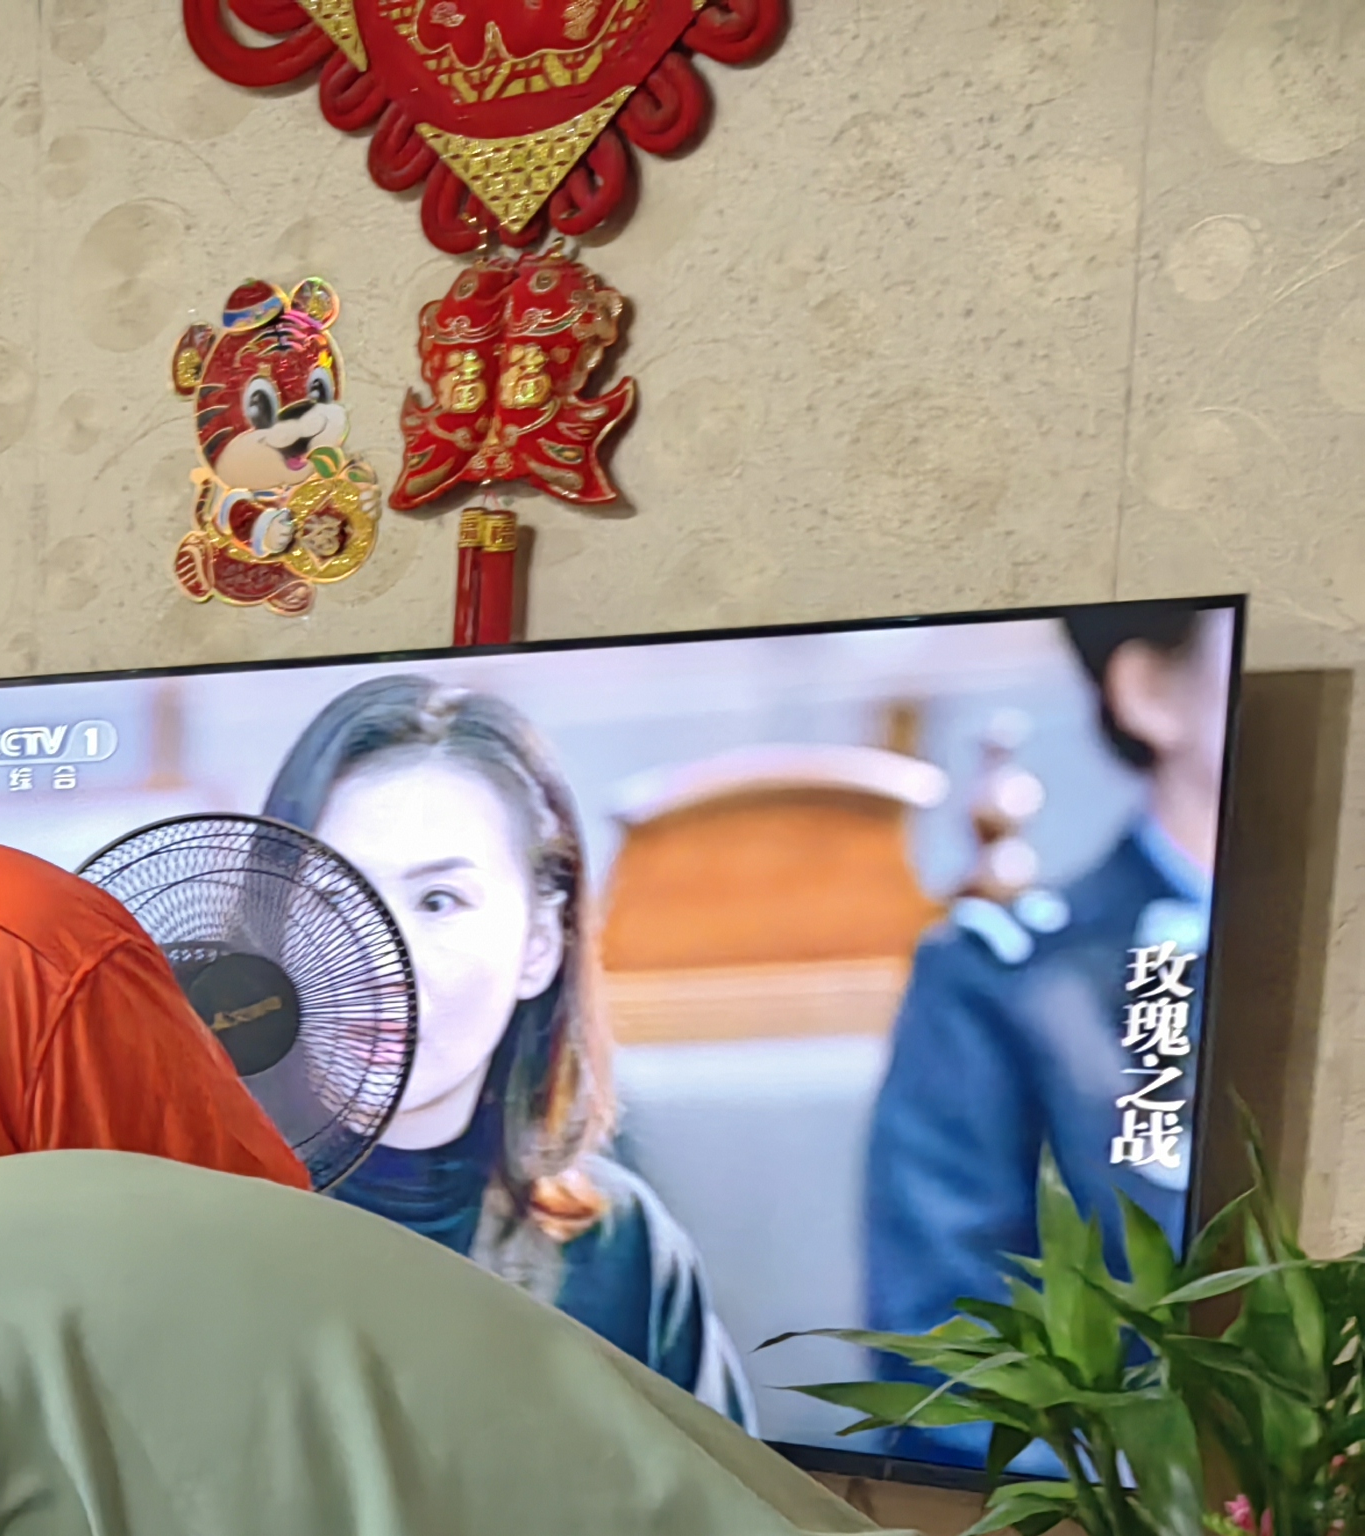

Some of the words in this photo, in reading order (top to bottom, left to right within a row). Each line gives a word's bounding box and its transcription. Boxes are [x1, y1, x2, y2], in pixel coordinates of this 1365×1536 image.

[84, 727, 98, 756] 1
[1109, 940, 1199, 1168] 玫瑰之战
